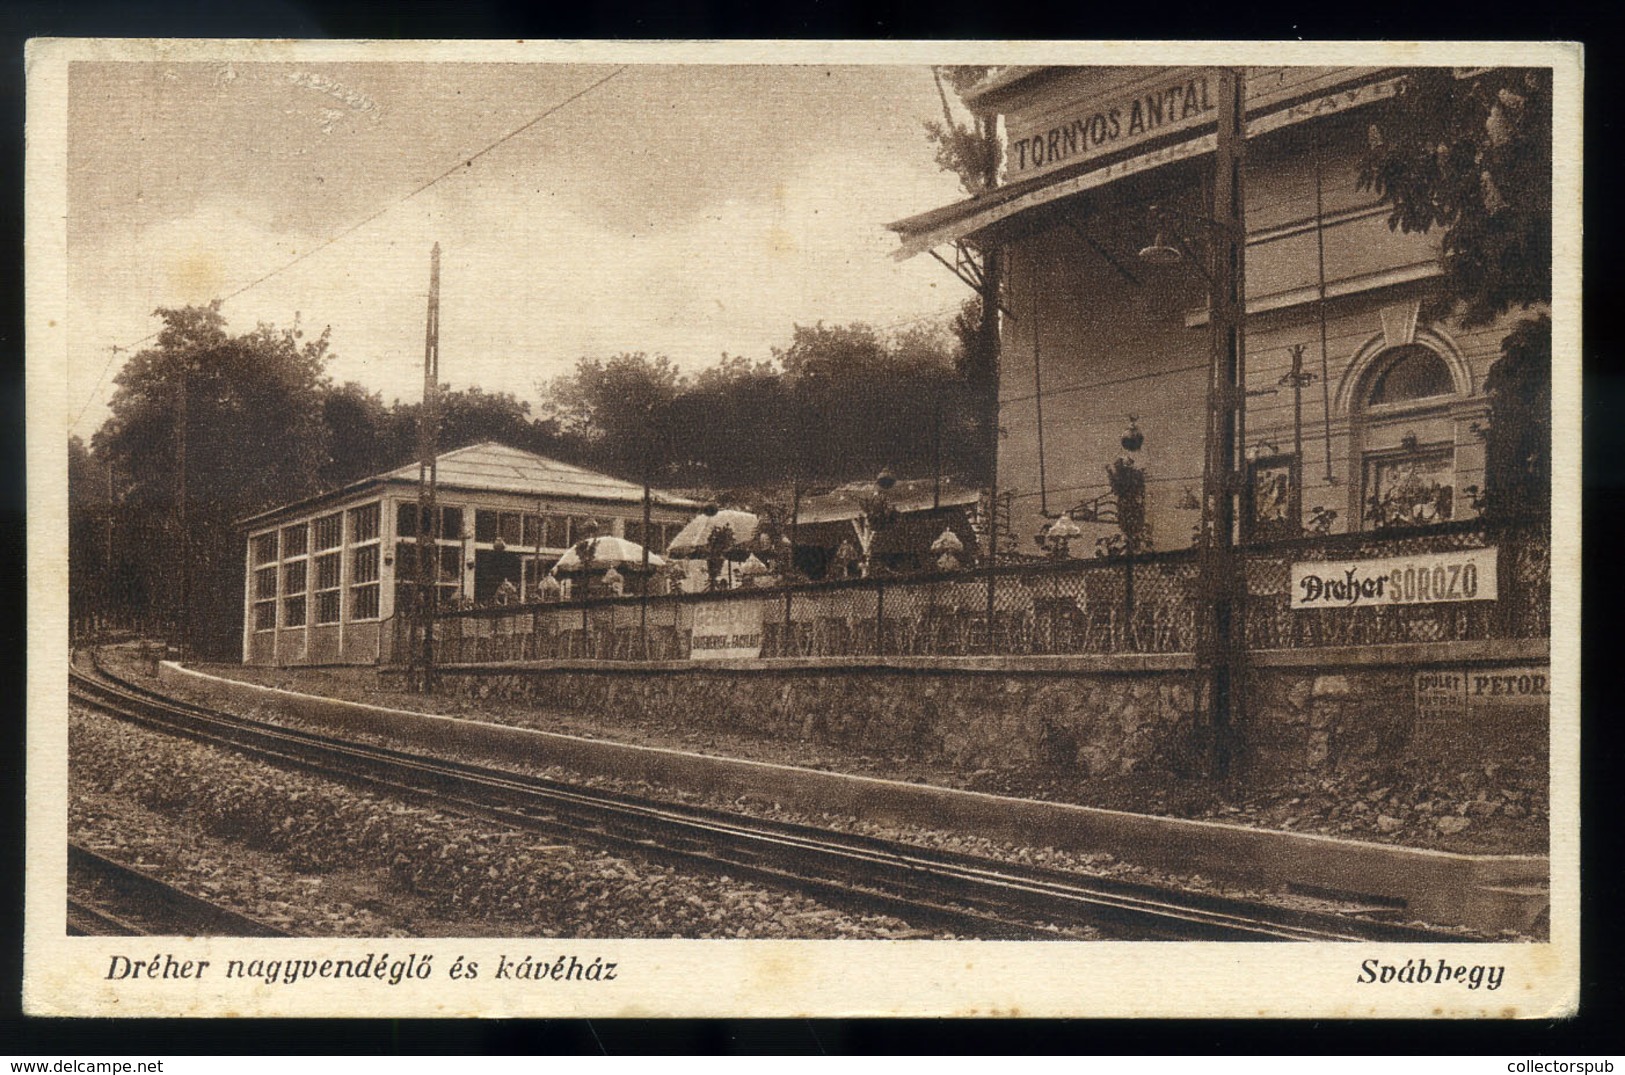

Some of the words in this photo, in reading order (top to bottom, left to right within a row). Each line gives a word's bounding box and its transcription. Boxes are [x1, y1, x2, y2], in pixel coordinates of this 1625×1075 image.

[1013, 107, 1121, 171] TORNYOS
[1128, 77, 1216, 136] ANTAL
[1299, 565, 1390, 606] Dreher
